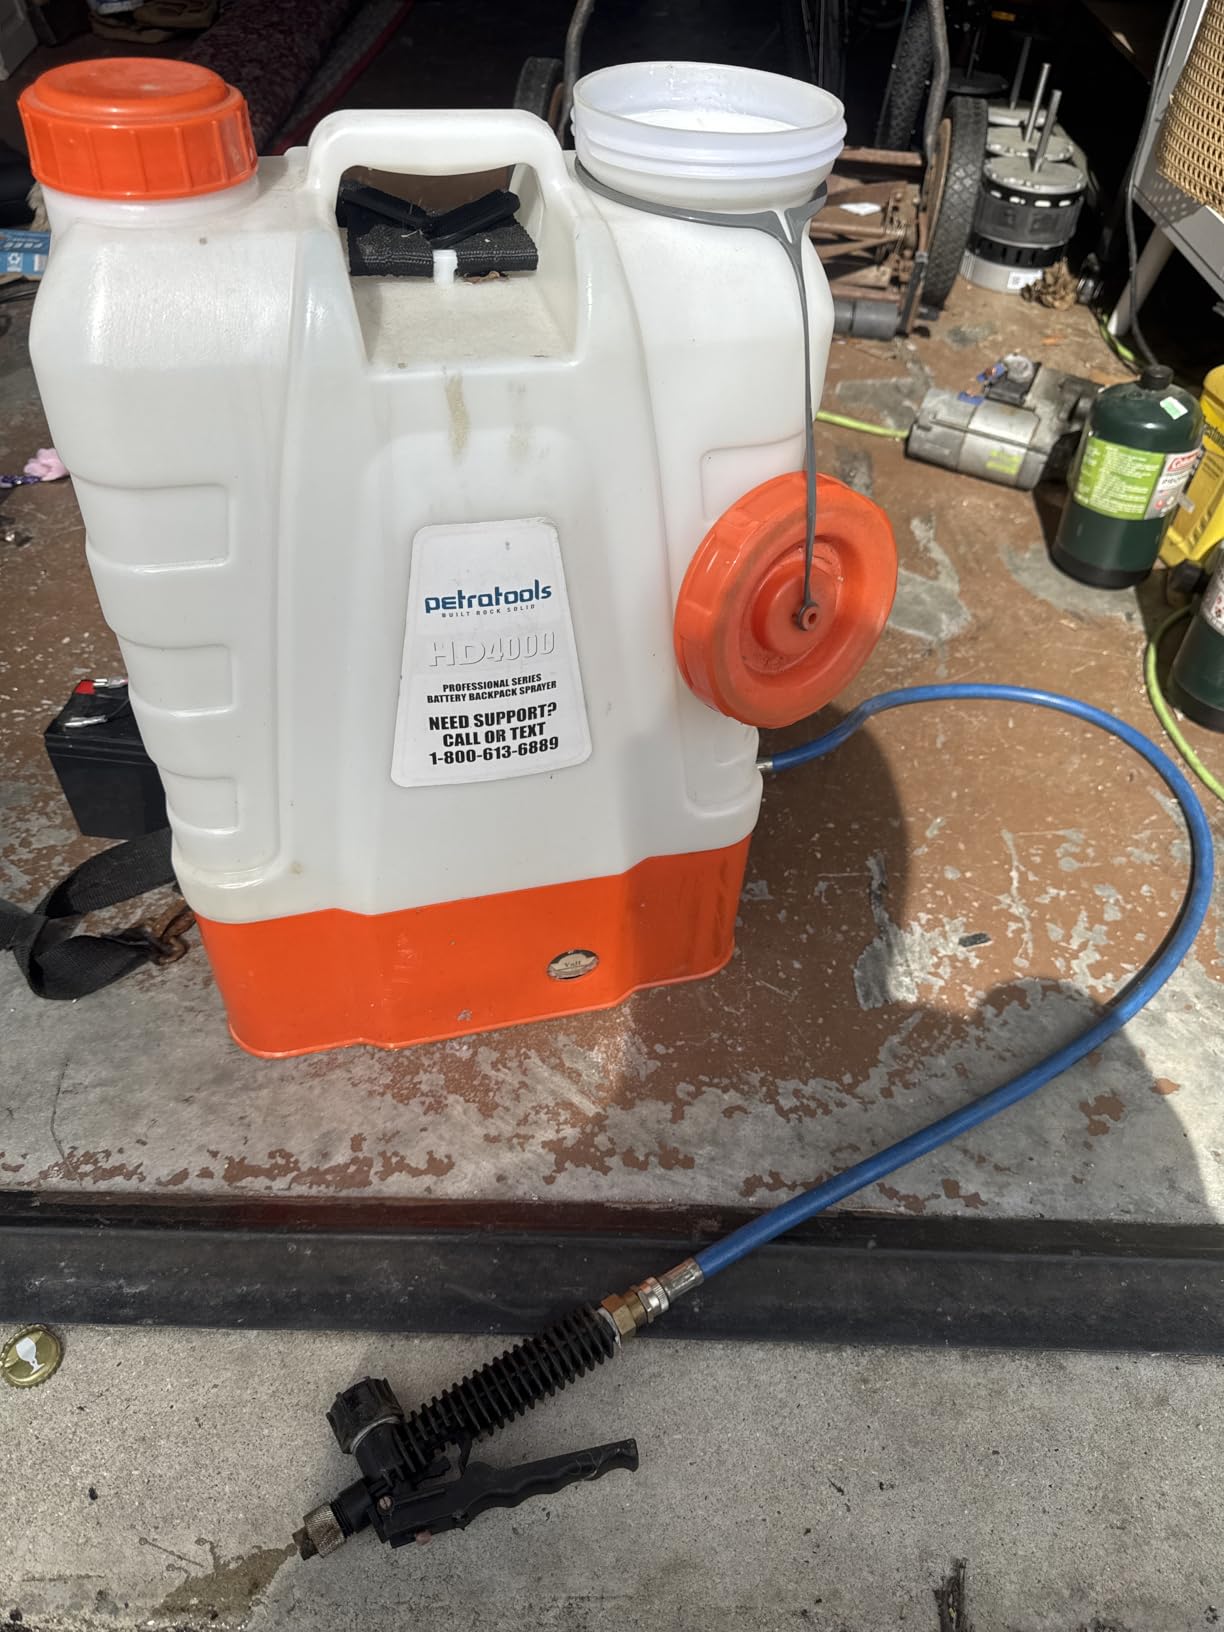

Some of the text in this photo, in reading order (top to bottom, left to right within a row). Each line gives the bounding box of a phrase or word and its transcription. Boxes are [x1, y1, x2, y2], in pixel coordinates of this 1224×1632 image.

[424, 578, 552, 614] petratools
[476, 607, 501, 616] ROCK
[506, 603, 536, 613] SOLID
[428, 631, 556, 668] HD4000
[426, 680, 557, 704] BATTERY BACKPACK SPRAYER
[442, 673, 542, 693] PROFESSIONAL SERIES
[428, 701, 558, 731] NEED SUPPORT?
[442, 721, 547, 748] CALL OR TEXT
[428, 736, 560, 766] 1-800-613-6889
